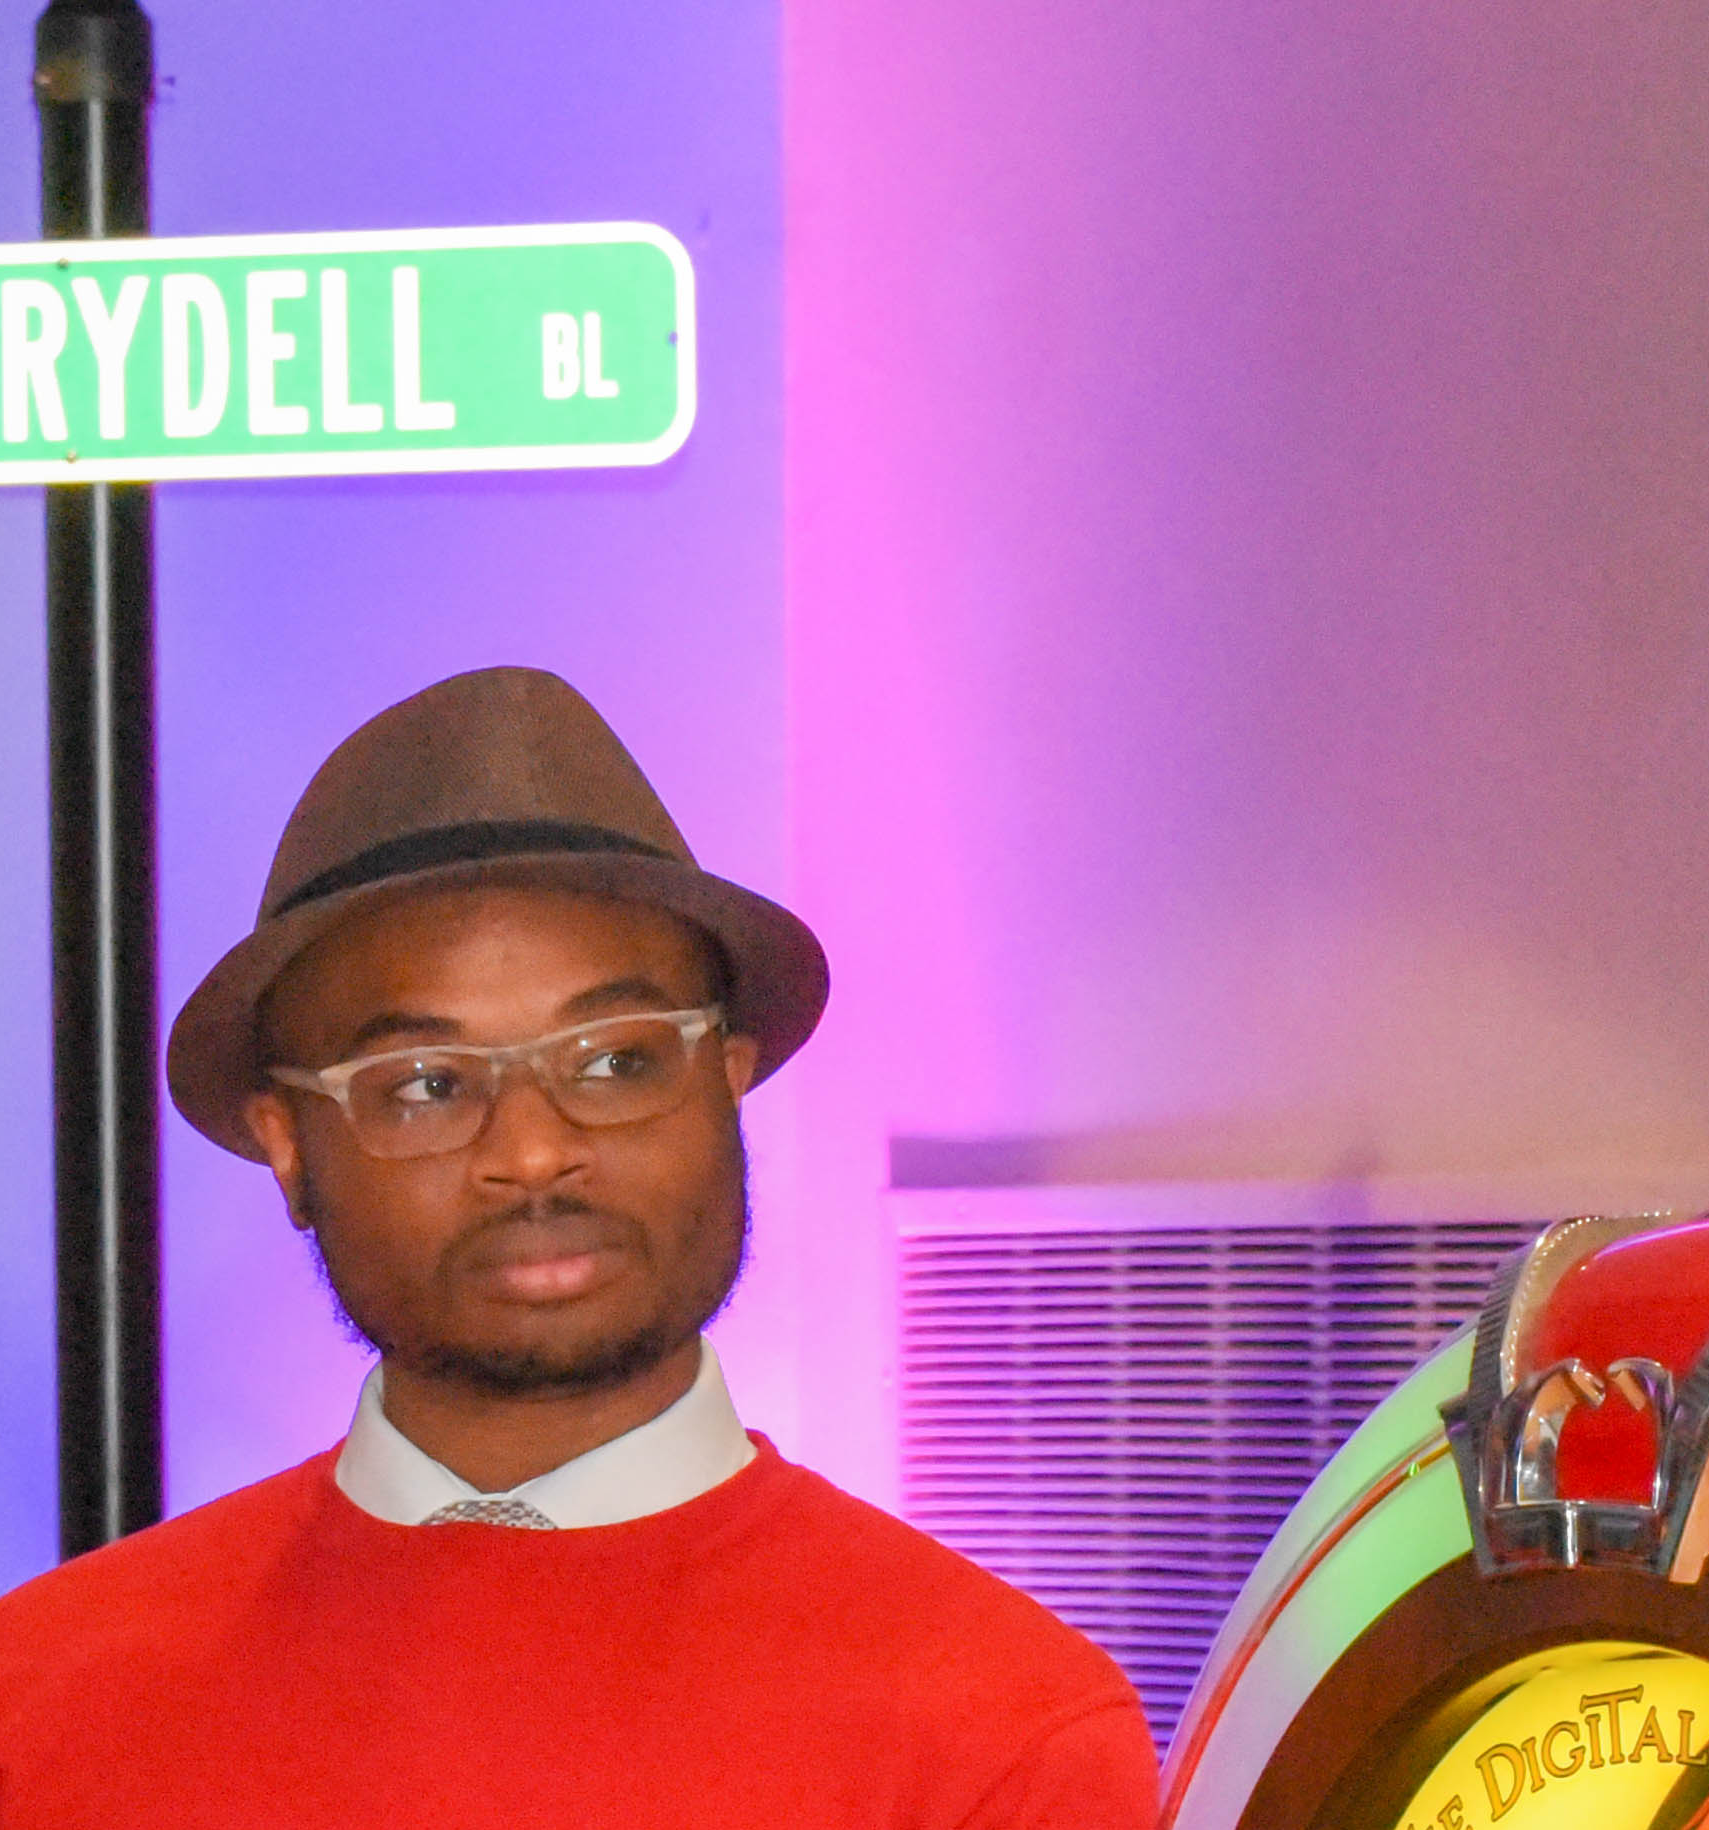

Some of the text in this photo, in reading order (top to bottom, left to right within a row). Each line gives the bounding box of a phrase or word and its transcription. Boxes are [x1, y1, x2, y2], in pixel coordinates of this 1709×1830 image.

[1, 265, 456, 444] RYDELL
[541, 310, 619, 400] BL
[1475, 1684, 1707, 1822] DIGITAL
